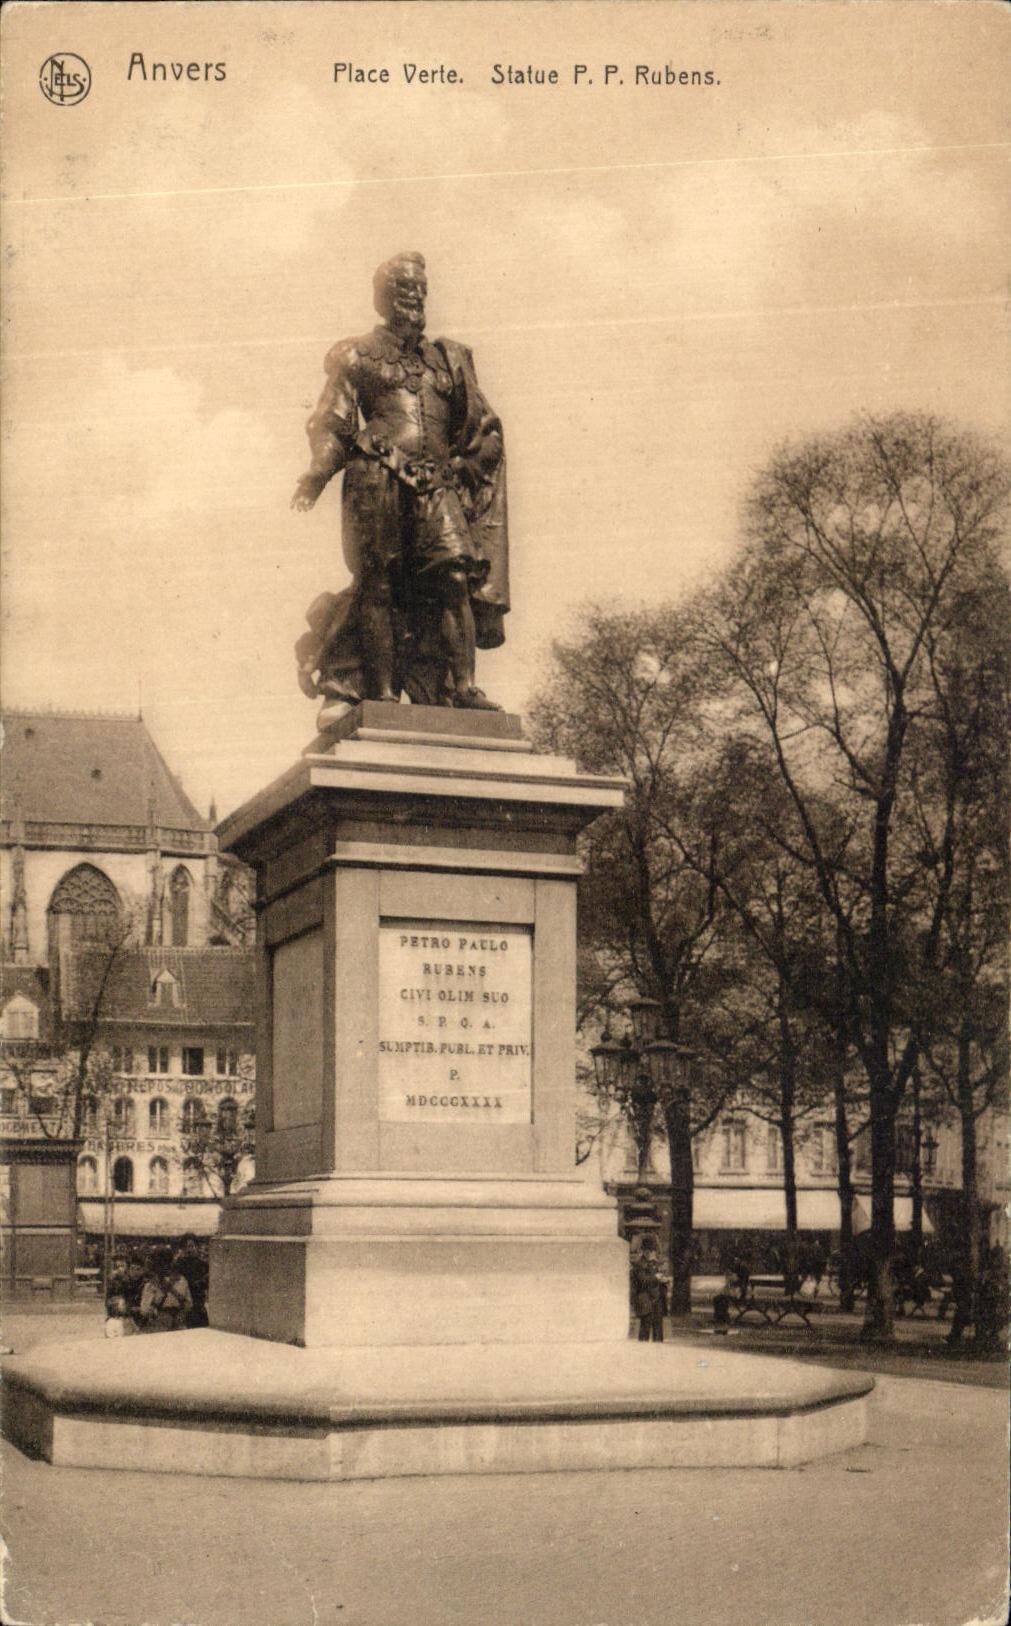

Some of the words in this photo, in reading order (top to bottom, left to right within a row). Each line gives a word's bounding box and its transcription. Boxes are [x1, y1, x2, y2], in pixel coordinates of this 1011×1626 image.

[399, 935, 451, 950] PETRO
[458, 937, 509, 952] PAULO
[422, 962, 487, 977] RUBENS
[399, 988, 431, 1001] CIVI
[437, 989, 474, 1002] OLIM
[482, 991, 509, 1004] SUO
[477, 1043, 494, 1056] ET
[497, 1043, 530, 1057] PRIV.
[405, 1094, 504, 1109] MDCCCXXXX
